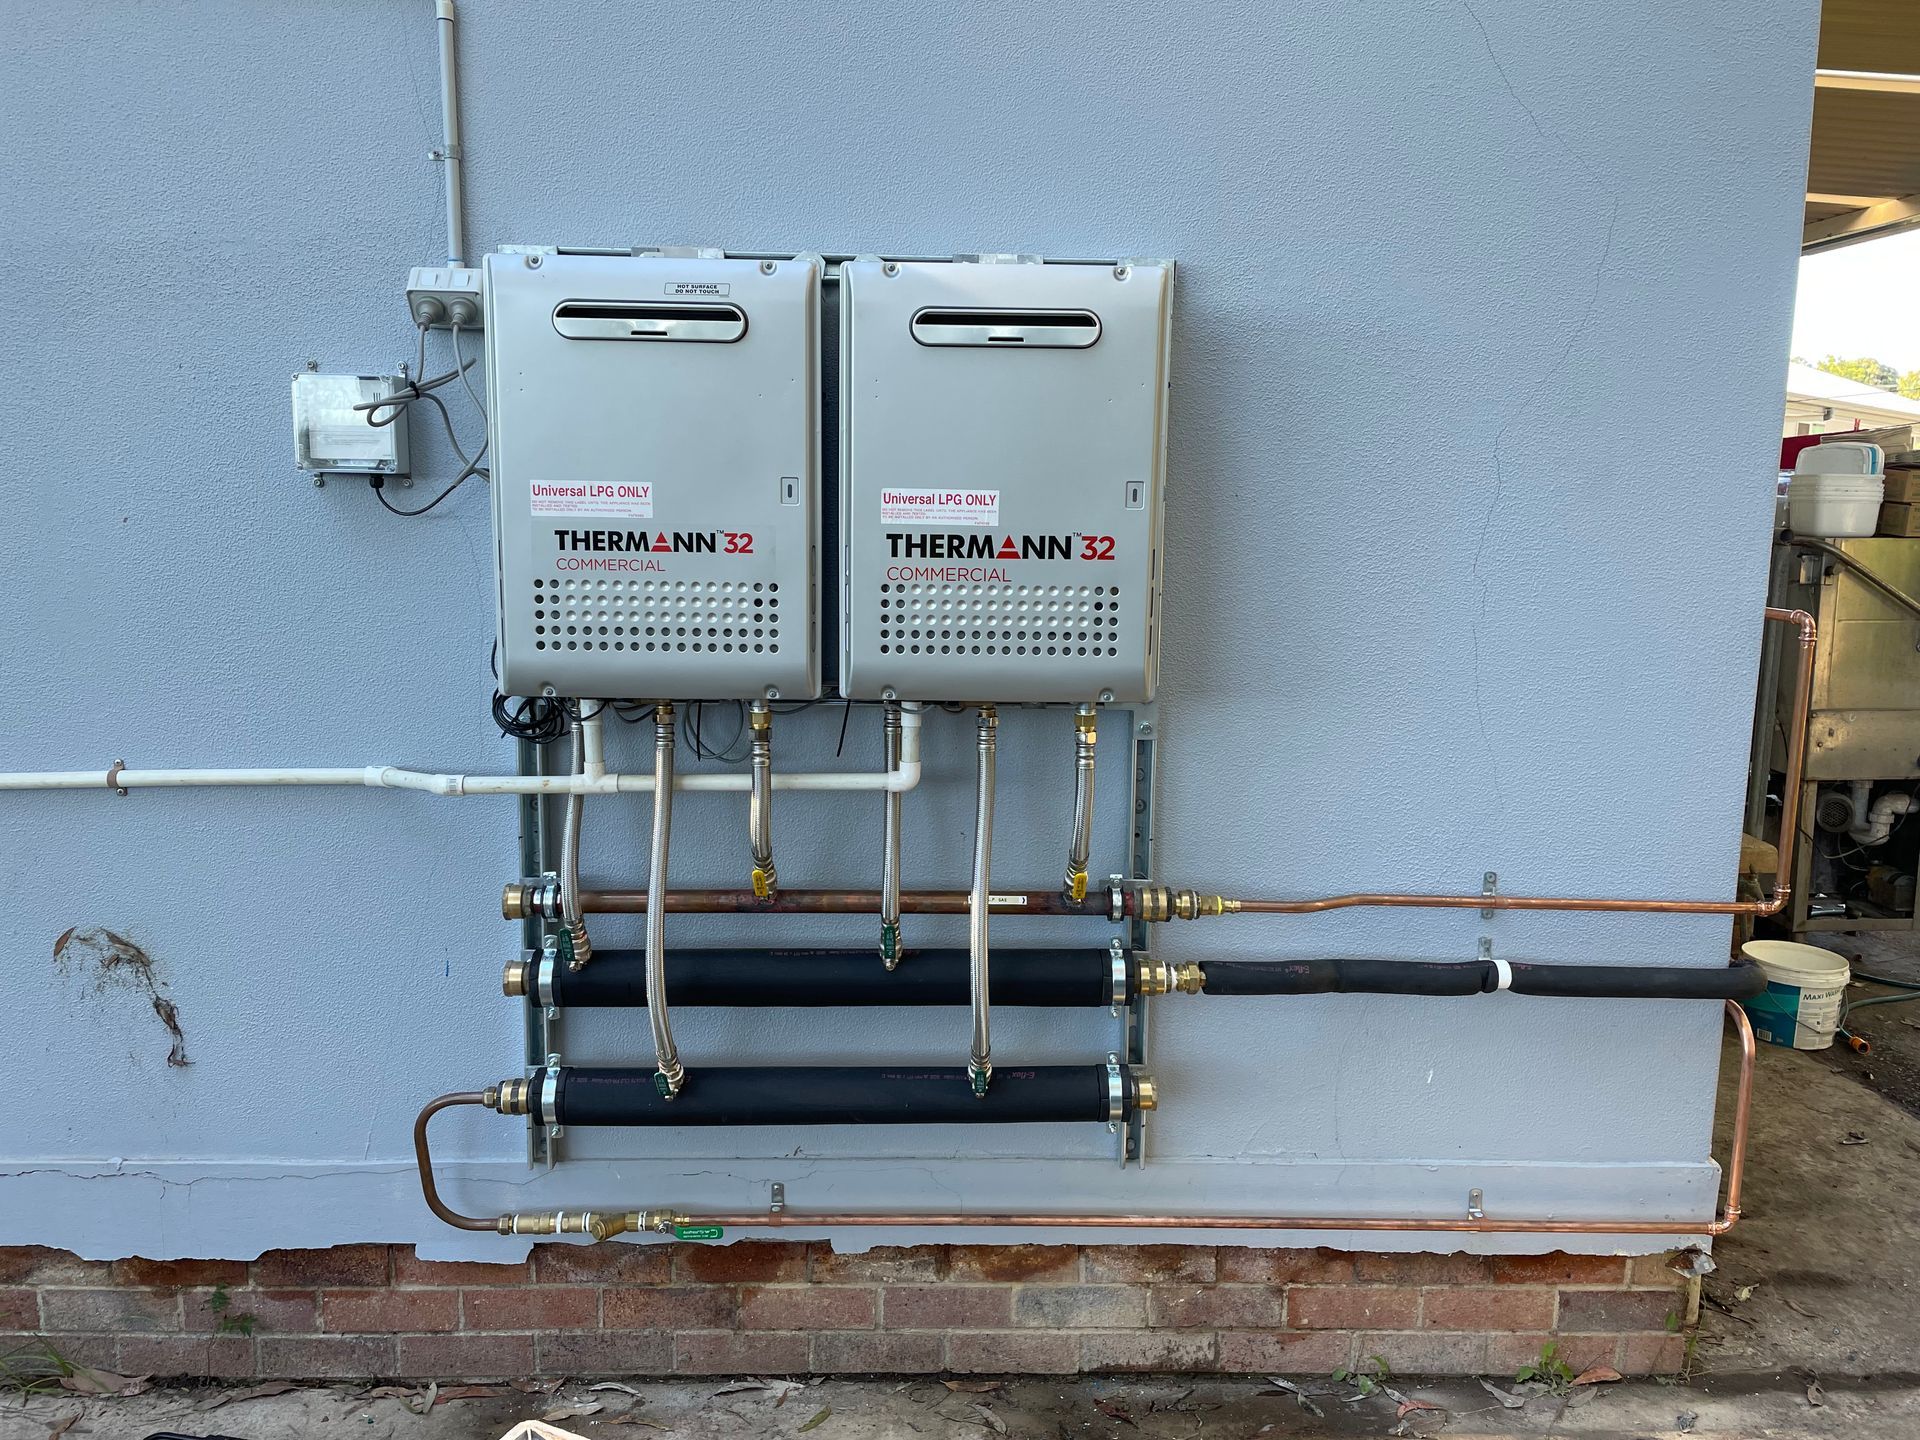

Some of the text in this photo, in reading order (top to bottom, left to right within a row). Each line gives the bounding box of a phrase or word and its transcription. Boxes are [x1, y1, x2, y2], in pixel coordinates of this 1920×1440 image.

[532, 484, 650, 498] Universal LPG ONLY
[883, 492, 997, 506] Universal LPG ONLY
[723, 532, 754, 554] 32
[1080, 536, 1116, 561] 32
[556, 558, 666, 572] COMMERCIAL
[887, 567, 1012, 582] COMMERCIAL
